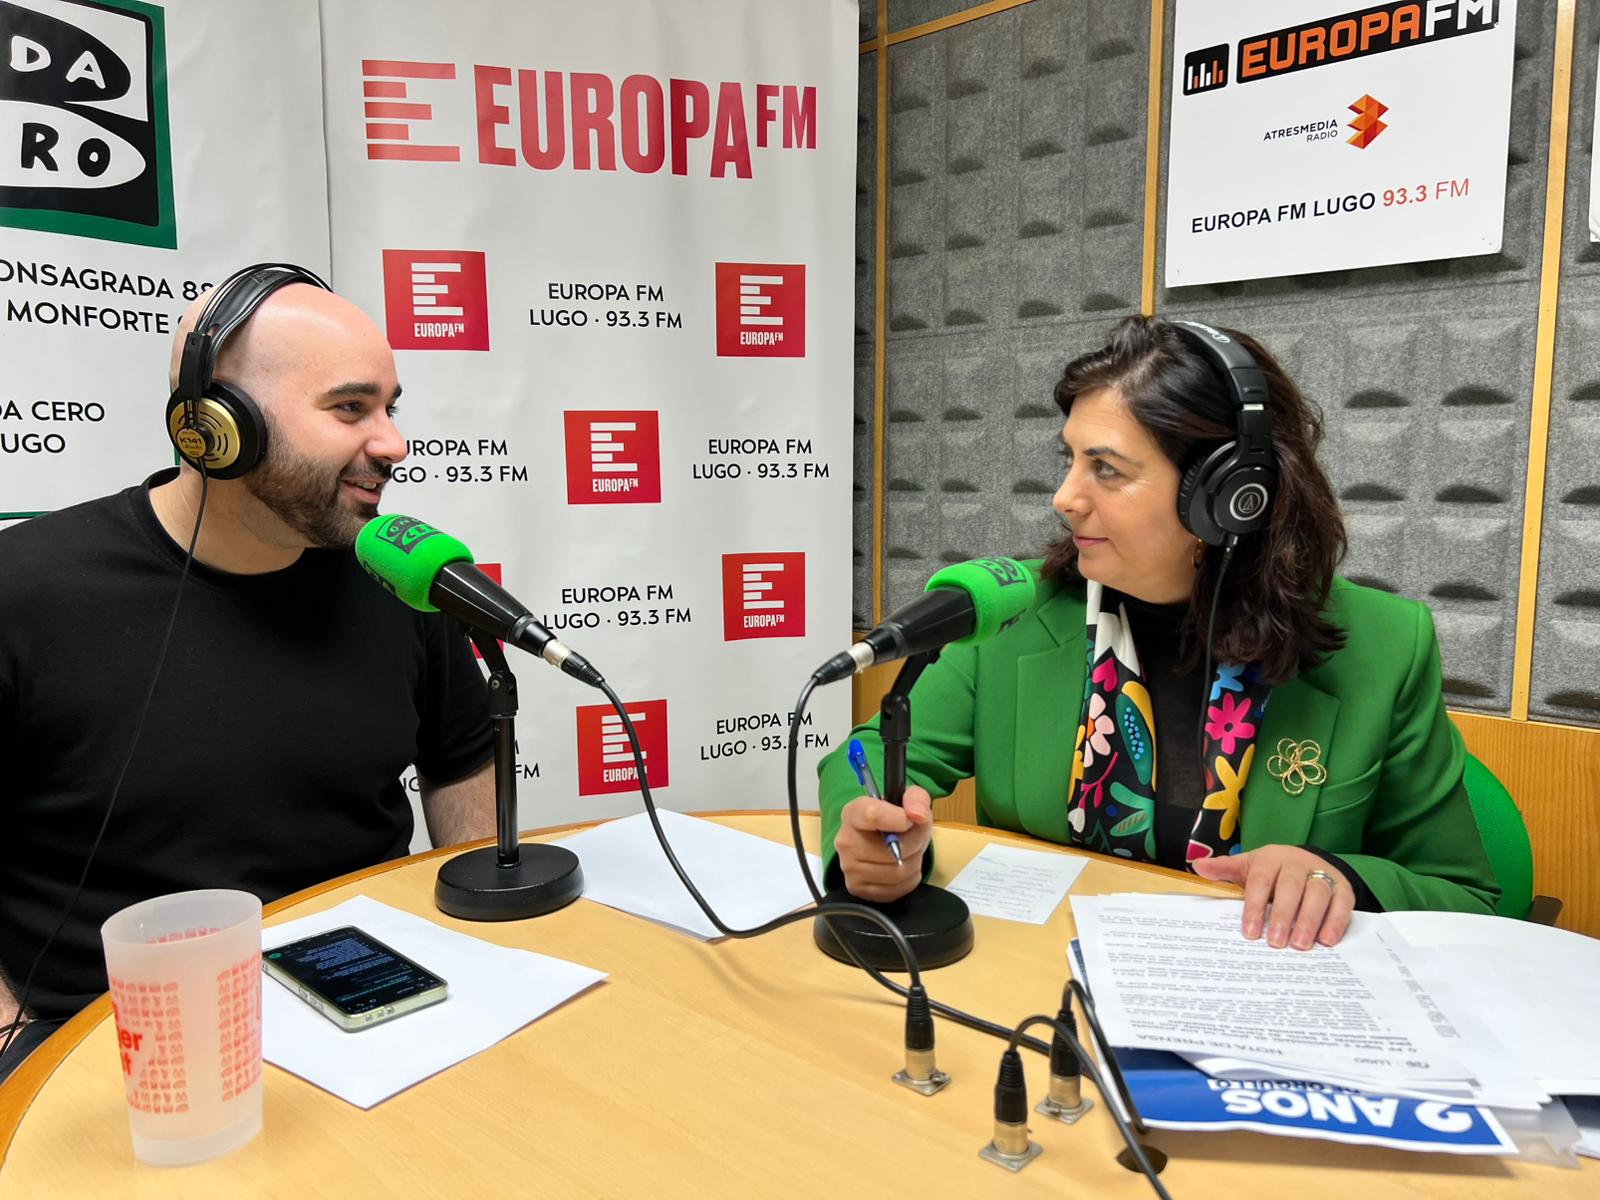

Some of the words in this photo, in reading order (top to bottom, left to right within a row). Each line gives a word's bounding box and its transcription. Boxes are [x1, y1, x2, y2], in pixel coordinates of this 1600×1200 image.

[1264, 119, 1338, 141] ATRESMEDIA
[1306, 129, 1338, 142] RADIO
[1191, 207, 1272, 234] EUROPA
[1277, 202, 1306, 222] FM
[1313, 192, 1376, 217] LUGO
[1383, 186, 1427, 207] 93.3
[1435, 179, 1469, 198] FM
[548, 282, 630, 301] EUROPA
[636, 284, 665, 302] FM
[8, 299, 169, 335] MONFORTE
[529, 308, 588, 327] LUGO
[605, 310, 650, 328] 93.3
[655, 311, 683, 329] FM
[0, 399, 23, 421] A
[31, 400, 105, 423] CERO
[406, 439, 472, 457] ROPA
[477, 439, 508, 456] FM
[708, 438, 781, 455] EUROPA
[786, 438, 812, 455] FM
[392, 466, 427, 484] GO
[446, 465, 493, 483] 93.3
[499, 465, 529, 482] FM
[692, 463, 742, 480] LUGO
[757, 462, 798, 479] 93.3
[803, 462, 830, 479] FM
[561, 585, 641, 605] EUROPA
[646, 584, 674, 601] FM
[543, 612, 601, 630] LUGO
[617, 609, 660, 627] 93.3
[665, 607, 692, 624] FM
[716, 712, 782, 735] EUROPA
[787, 711, 813, 727] FM
[700, 739, 748, 761] LUGO
[761, 735, 797, 752] 93.
[804, 733, 830, 749] FM
[1221, 1089, 1400, 1128] ANOS
